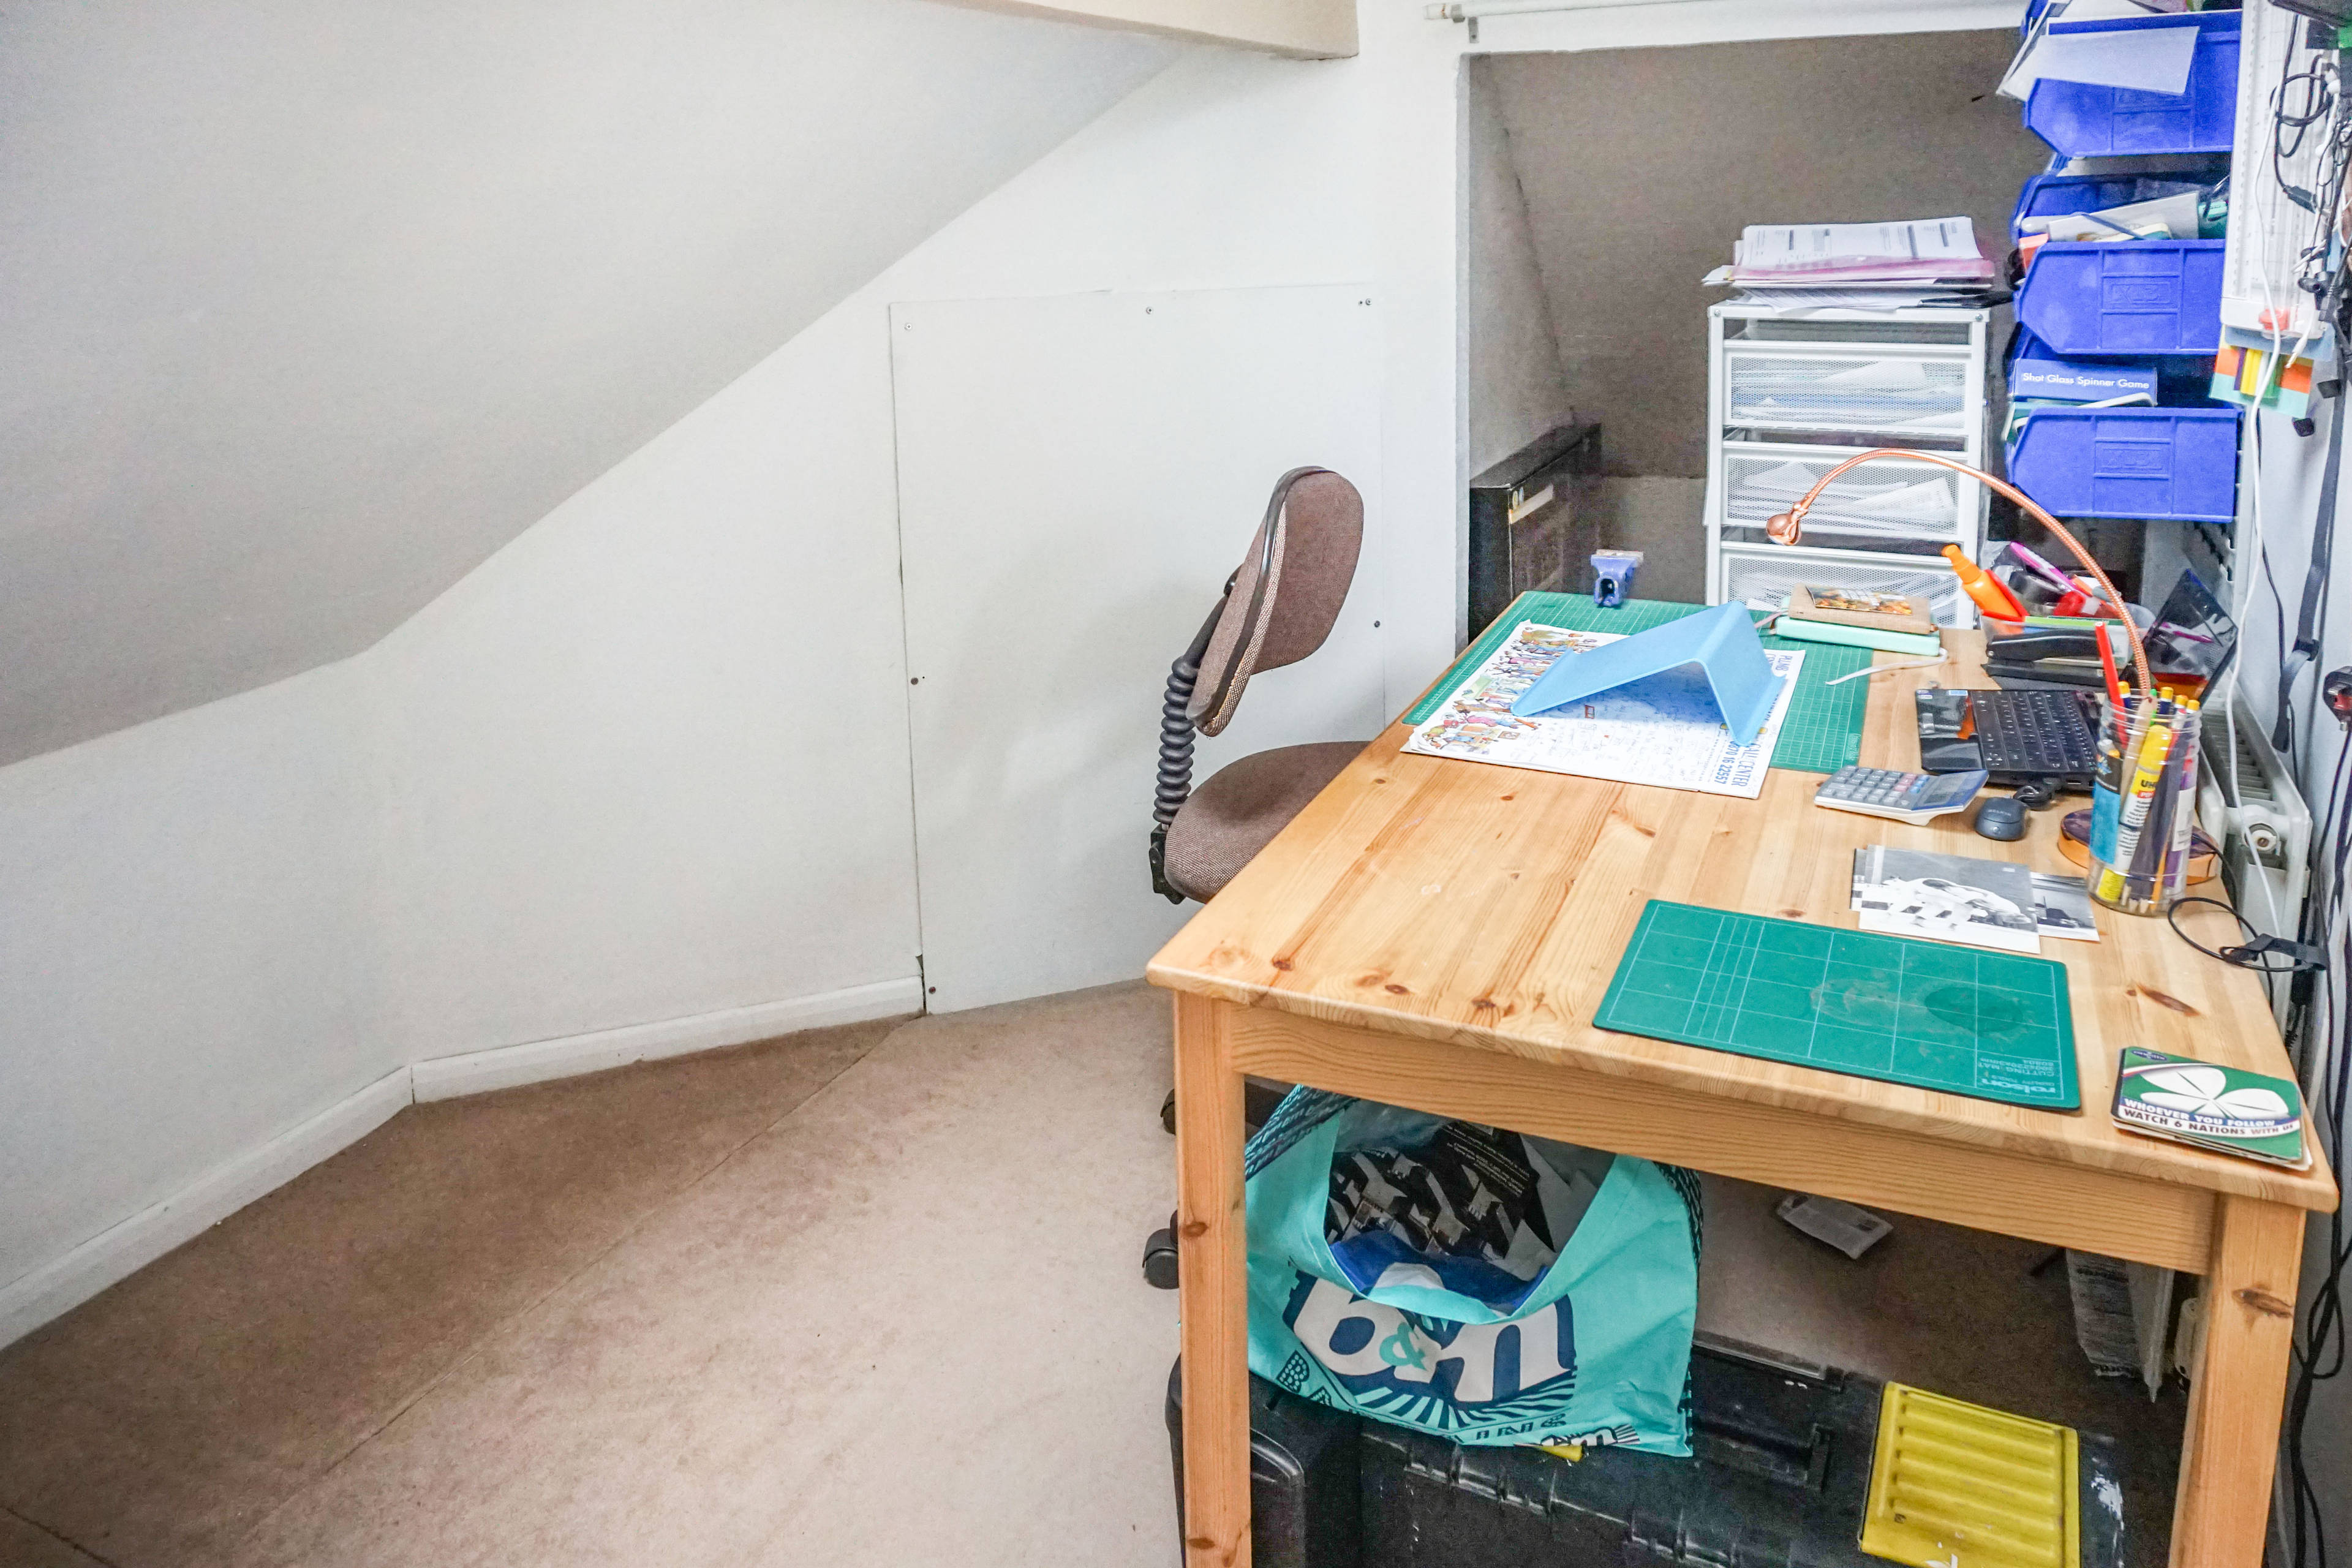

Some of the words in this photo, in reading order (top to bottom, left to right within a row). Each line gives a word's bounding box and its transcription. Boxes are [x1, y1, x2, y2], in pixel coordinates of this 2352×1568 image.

[2022, 372, 2045, 382] Shot
[2047, 374, 2075, 384] Glass
[2077, 376, 2115, 387] Spinner
[2118, 379, 2149, 389] Game
[1714, 765, 1732, 785] 22557
[1731, 761, 1755, 786] CENTER
[2006, 1066, 2055, 1077] CUTTING
[1981, 1078, 2056, 1093] rolson
[2124, 1098, 2190, 1120] WHOEVER
[2194, 1115, 2223, 1125] YOU
[2124, 1109, 2168, 1125] WATCH
[2188, 1122, 2245, 1134] NATIONS
[2251, 1126, 2278, 1135] WITH
